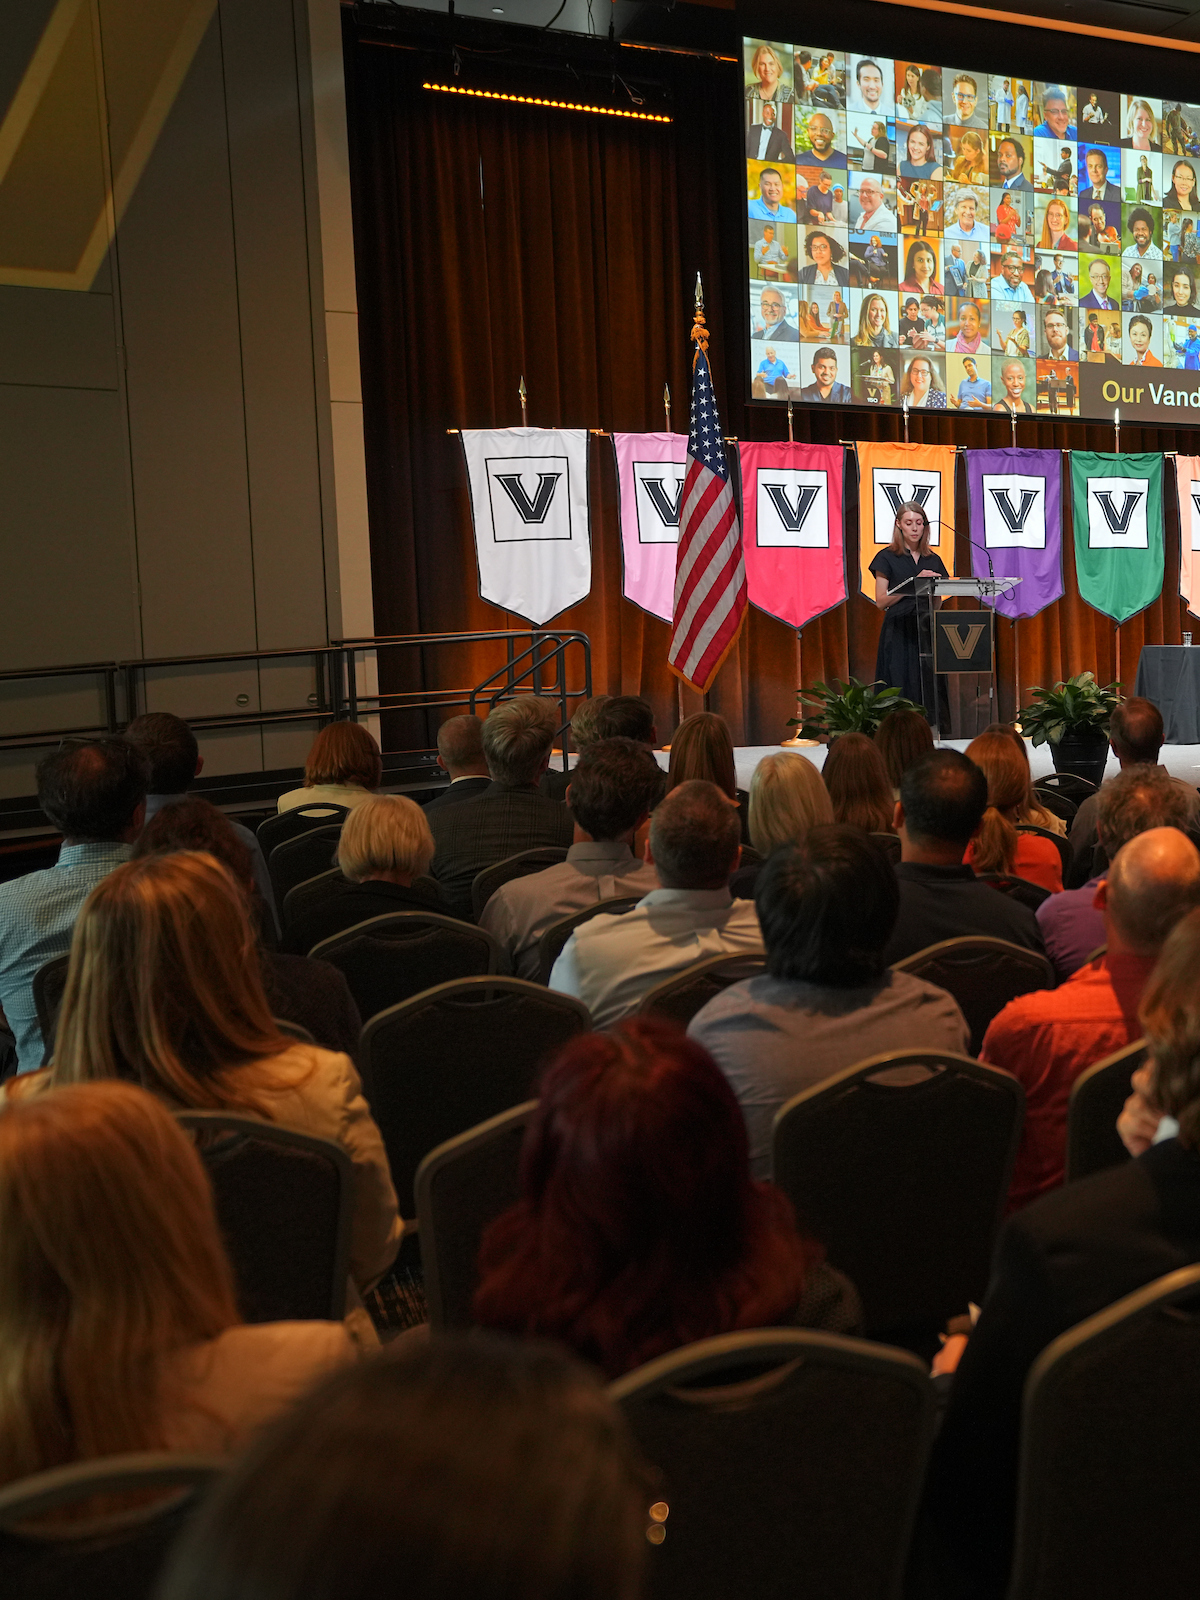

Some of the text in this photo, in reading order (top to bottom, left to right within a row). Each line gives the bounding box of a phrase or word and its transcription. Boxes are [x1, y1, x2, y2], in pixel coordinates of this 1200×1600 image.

[1101, 380, 1144, 404] Our
[493, 472, 563, 524] V
[761, 483, 824, 532] V
[988, 488, 1040, 533] V
[1092, 490, 1145, 534] V
[941, 624, 986, 660] V
